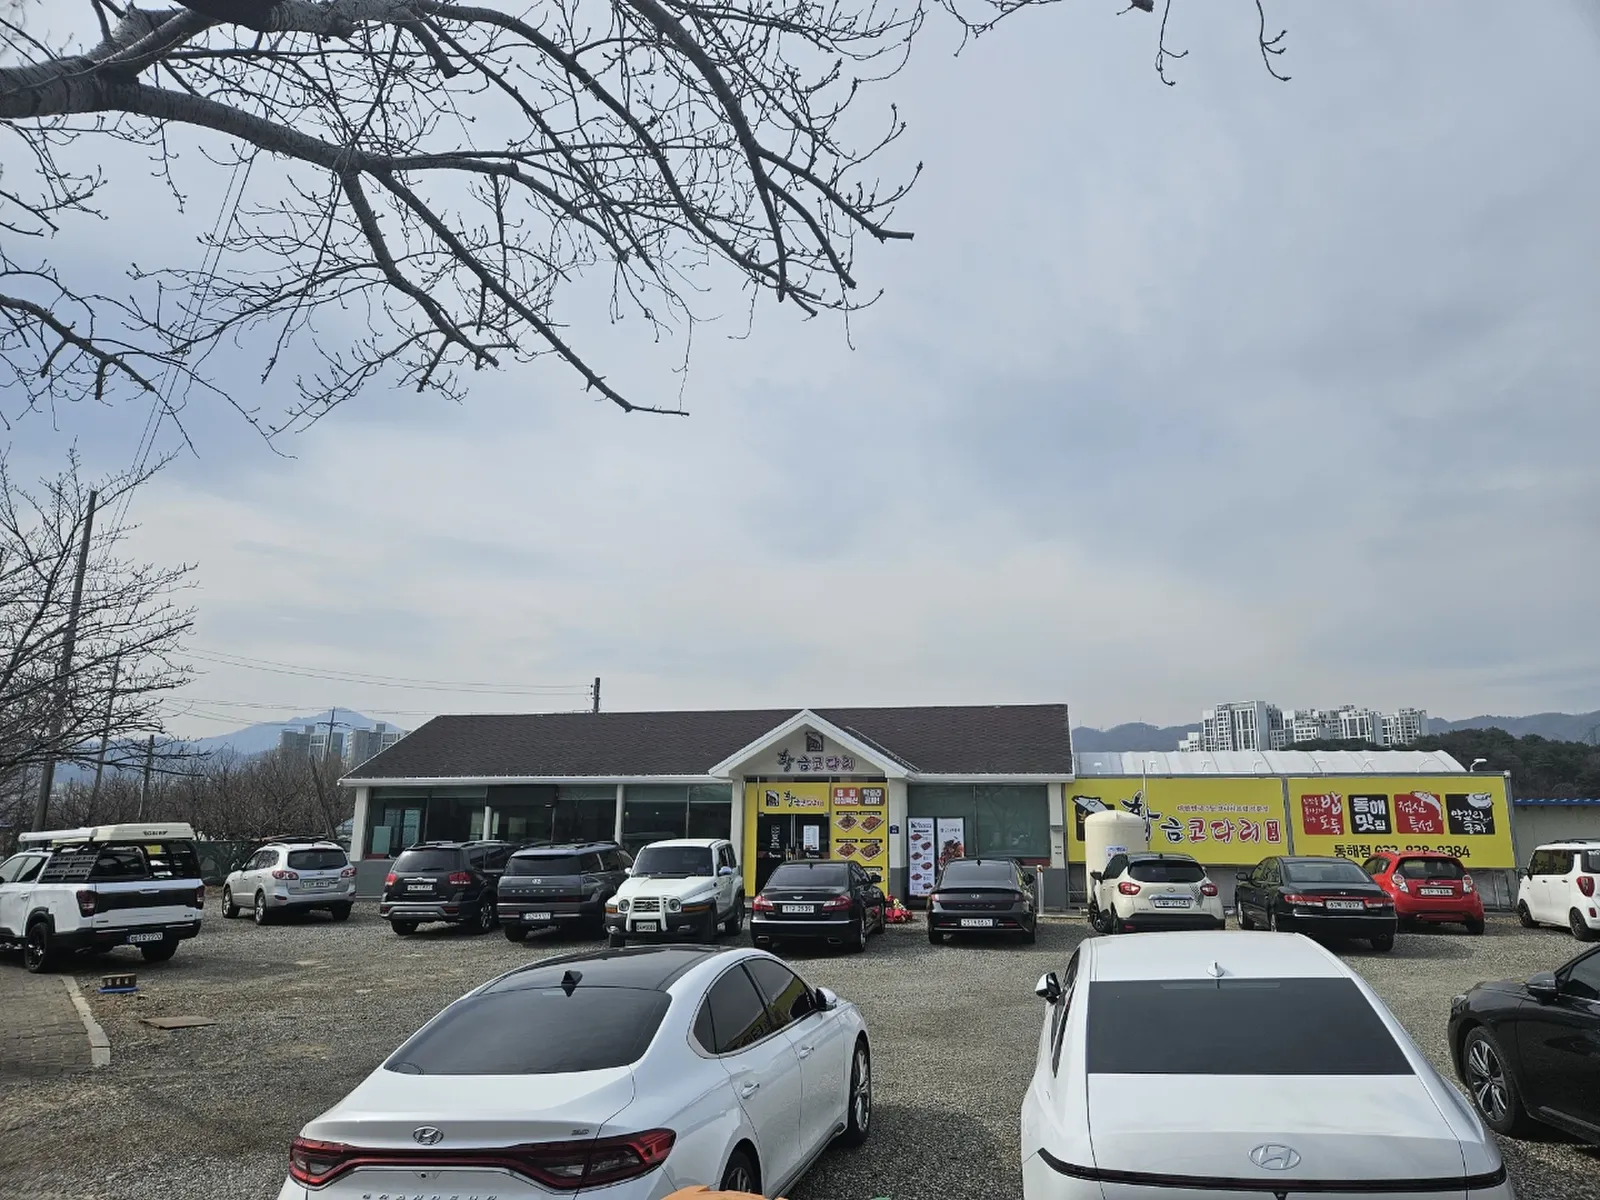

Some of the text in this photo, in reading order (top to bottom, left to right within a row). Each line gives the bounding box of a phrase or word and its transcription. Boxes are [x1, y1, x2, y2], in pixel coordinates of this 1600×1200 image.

[1398, 801, 1427, 814] 점심
[1355, 814, 1386, 831] 맛집
[1408, 816, 1434, 832] 특선
[1334, 844, 1370, 858] 동해점
